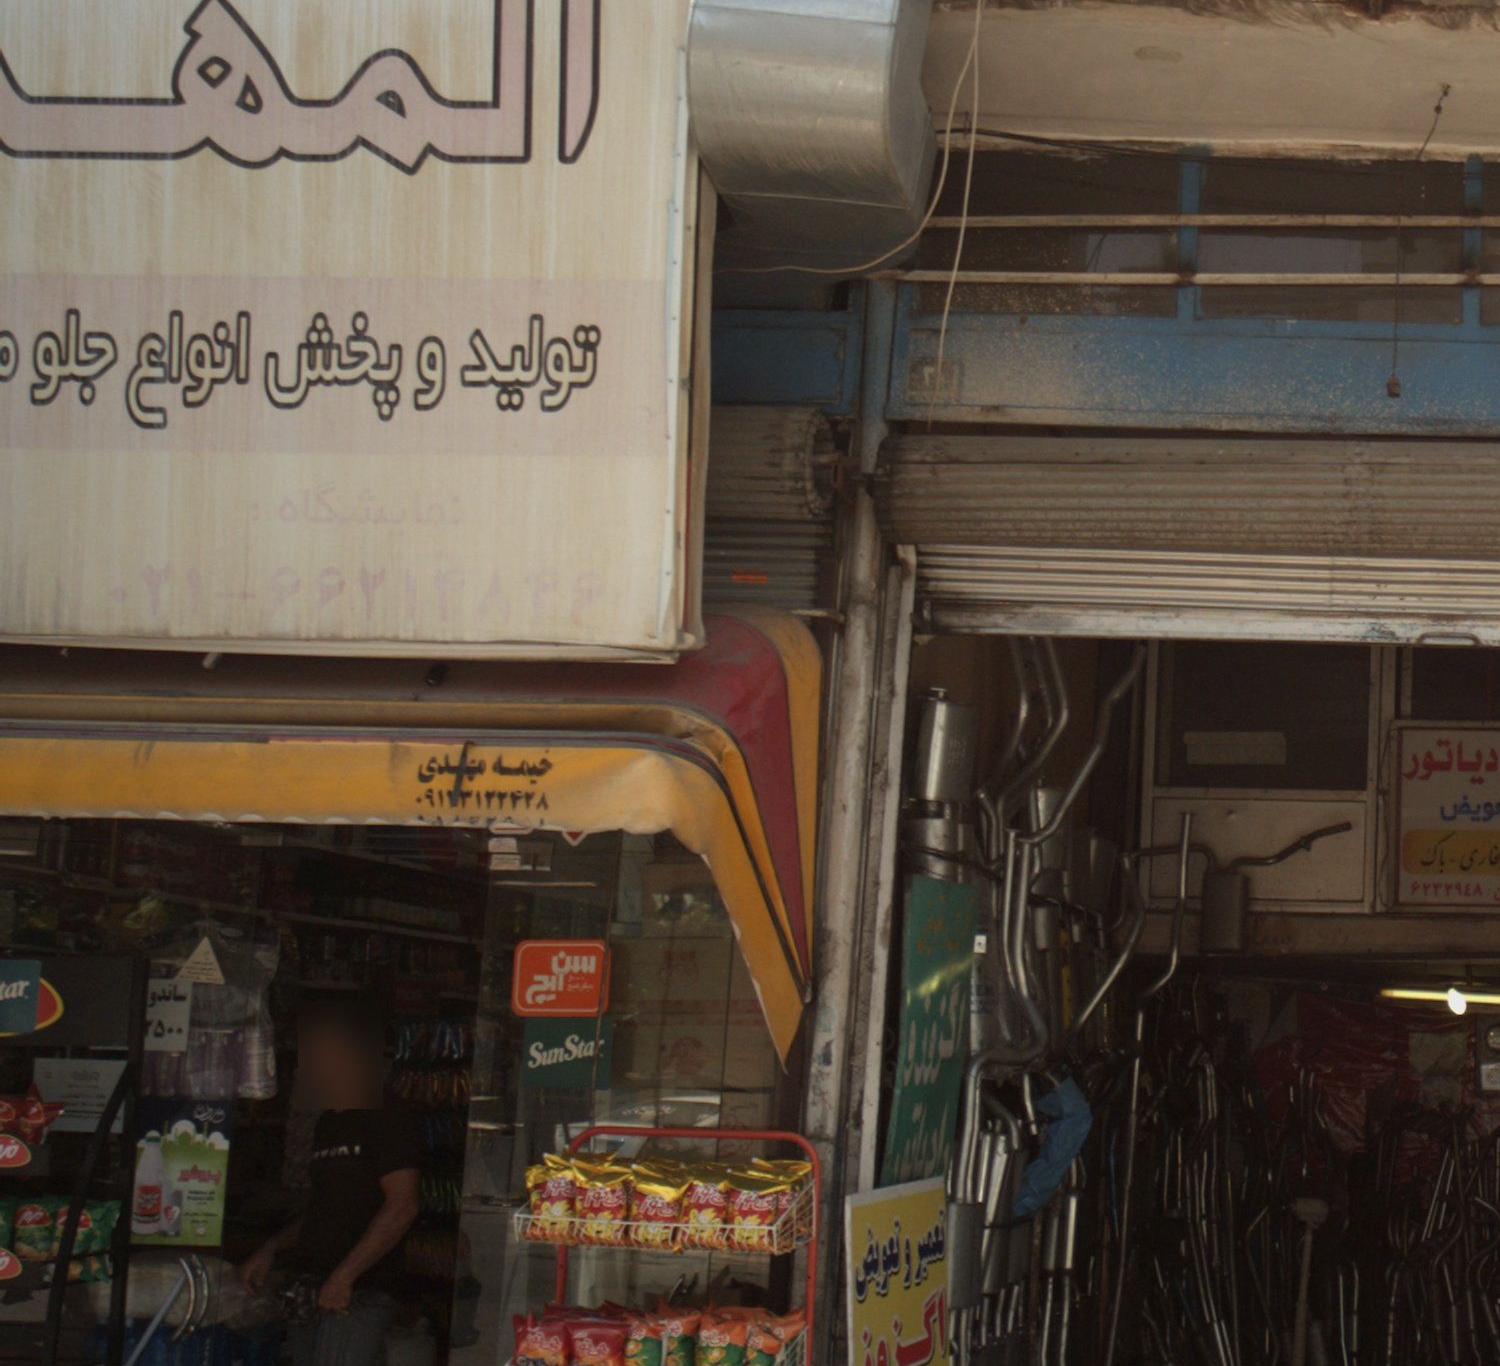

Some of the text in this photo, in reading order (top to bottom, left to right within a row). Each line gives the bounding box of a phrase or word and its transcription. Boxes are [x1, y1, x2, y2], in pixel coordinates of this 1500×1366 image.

[31, 308, 119, 408] جلو
[125, 310, 252, 429] انواع
[264, 310, 403, 421] پخش
[413, 335, 447, 411] و
[460, 313, 602, 413] تولید
[147, 983, 187, 1008] ساندو
[551, 950, 597, 975] سن
[855, 1209, 946, 1302] تعمیر و تعویض
